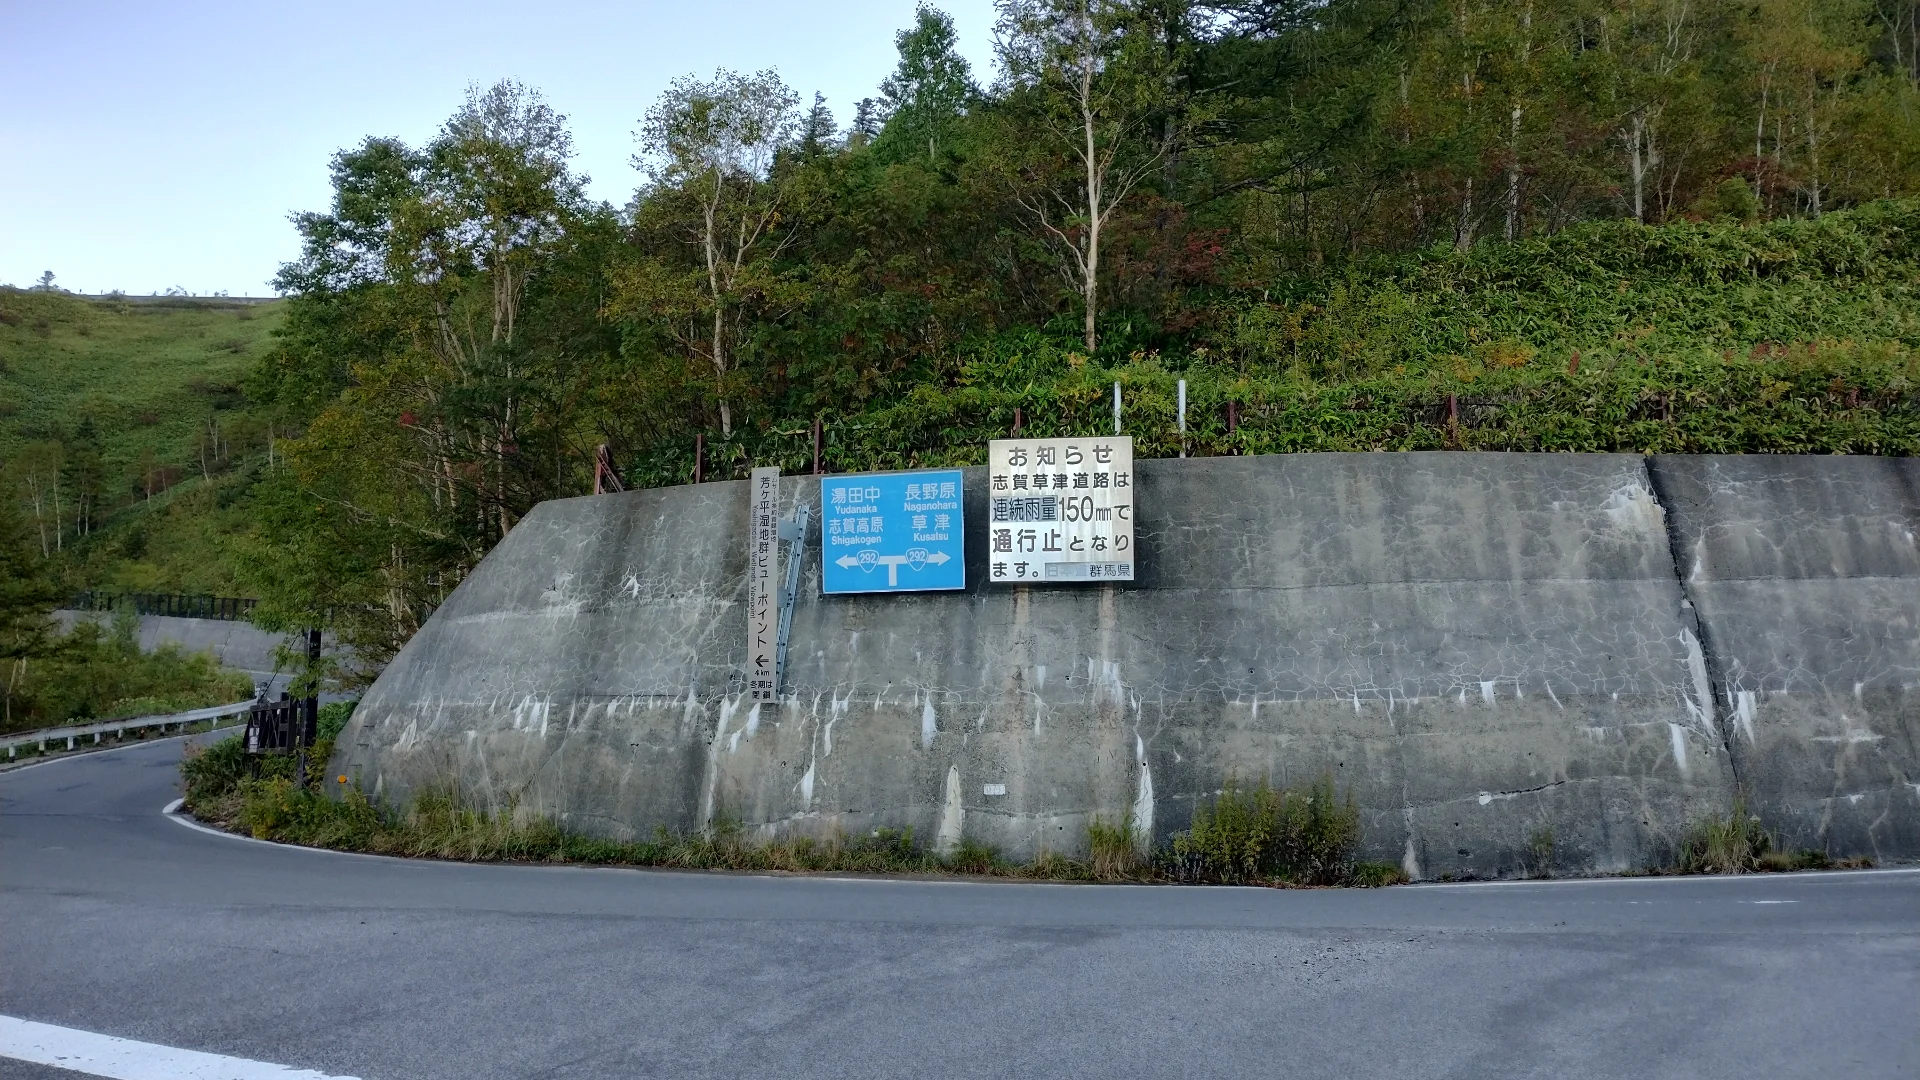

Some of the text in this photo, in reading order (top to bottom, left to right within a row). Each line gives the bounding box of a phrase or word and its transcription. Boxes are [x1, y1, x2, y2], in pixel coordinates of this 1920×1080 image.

[1008, 445, 1113, 467] お知らせ
[992, 472, 1130, 490] 志賀草津道路は
[831, 486, 880, 504] 湯田中
[905, 482, 956, 501] 長野原
[835, 505, 877, 514] Yudanaka
[904, 501, 957, 512] Naganohara
[829, 516, 884, 534] 志賀高原
[912, 514, 951, 531] 草津
[831, 535, 882, 546] Shigakogen
[913, 532, 949, 541] Kusatsu
[993, 529, 1129, 553] 通行止となり
[860, 552, 876, 563] 292
[909, 551, 926, 561] 292
[750, 551, 758, 582] Wetlands
[992, 561, 1039, 578] ます。
[1089, 564, 1131, 578] 群馬県
[750, 680, 773, 689] 冬期は
